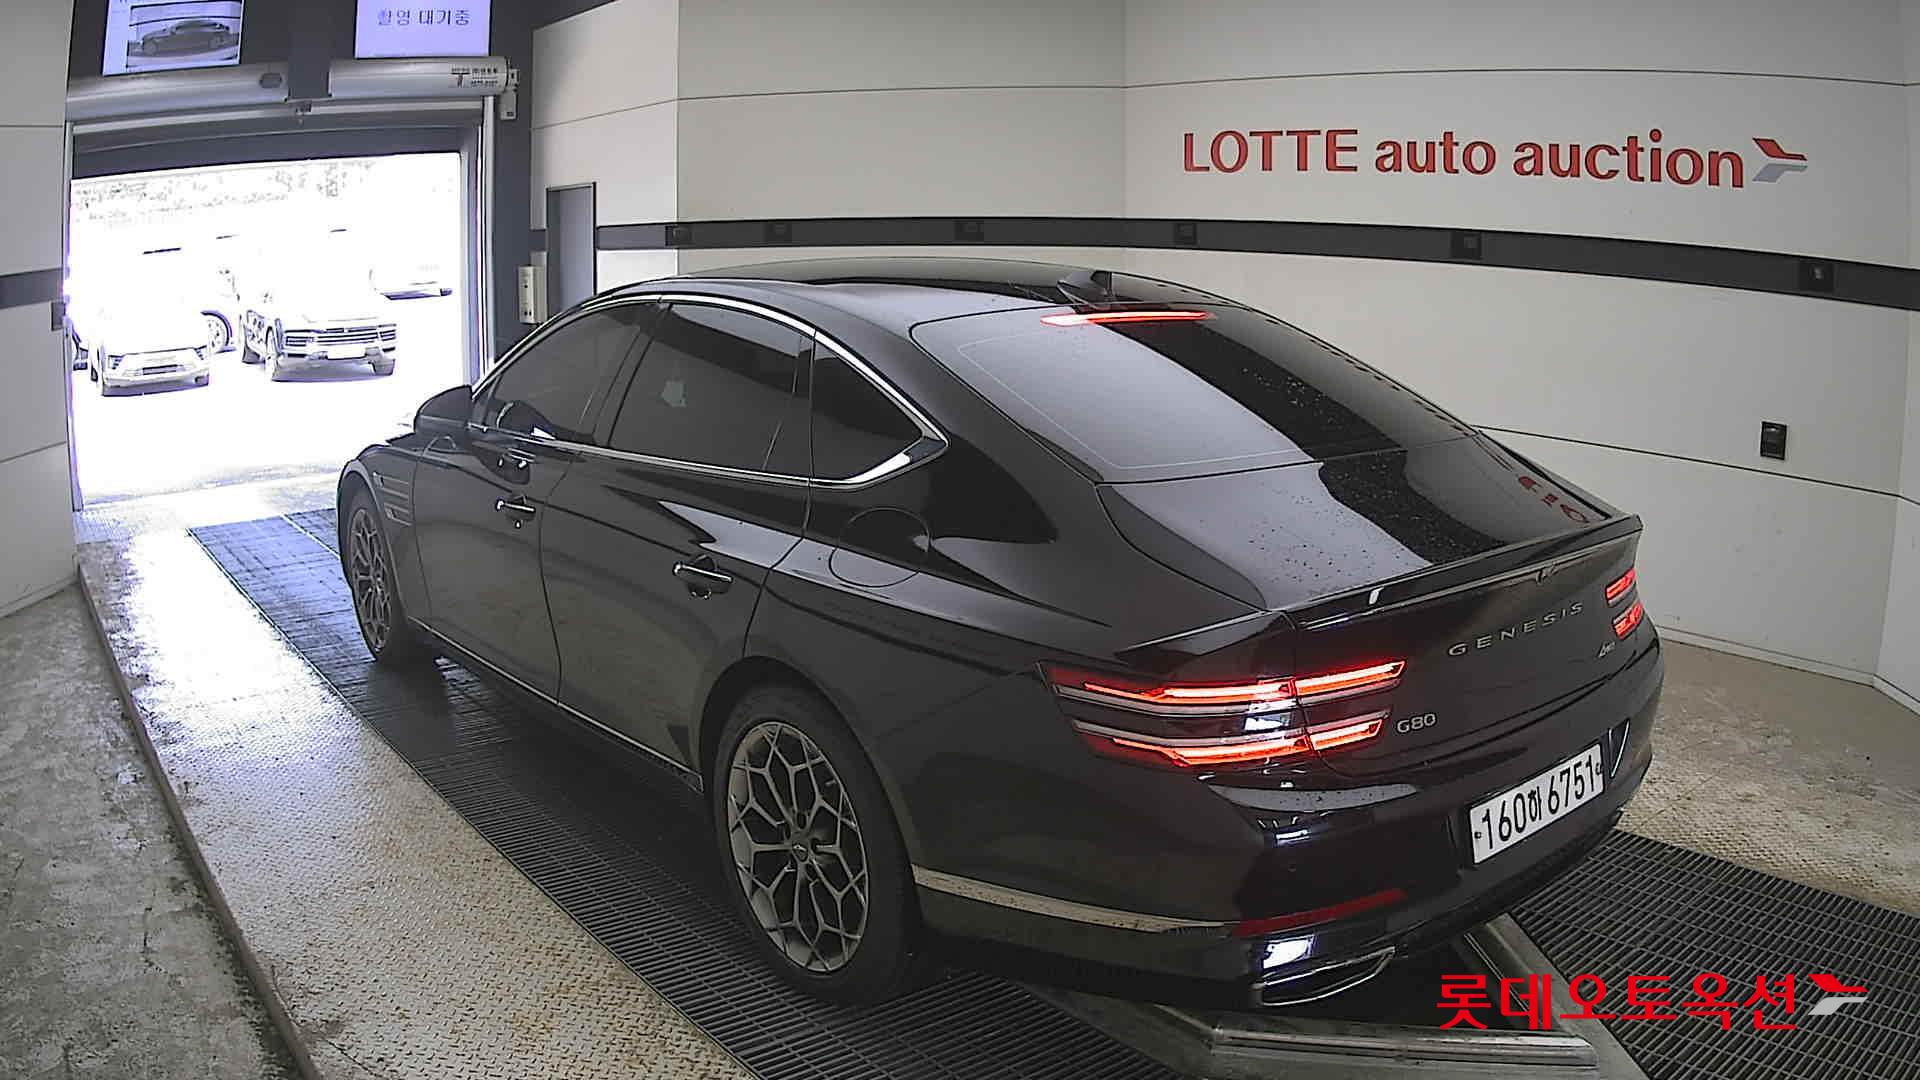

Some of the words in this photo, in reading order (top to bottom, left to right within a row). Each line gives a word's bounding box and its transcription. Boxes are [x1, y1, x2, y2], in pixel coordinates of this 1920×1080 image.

[1183, 130, 1358, 173] LOTTE
[1375, 132, 1497, 175] auto
[1513, 129, 1744, 188] auction
[1448, 601, 1583, 656] GENESIS
[1396, 712, 1437, 733] G80
